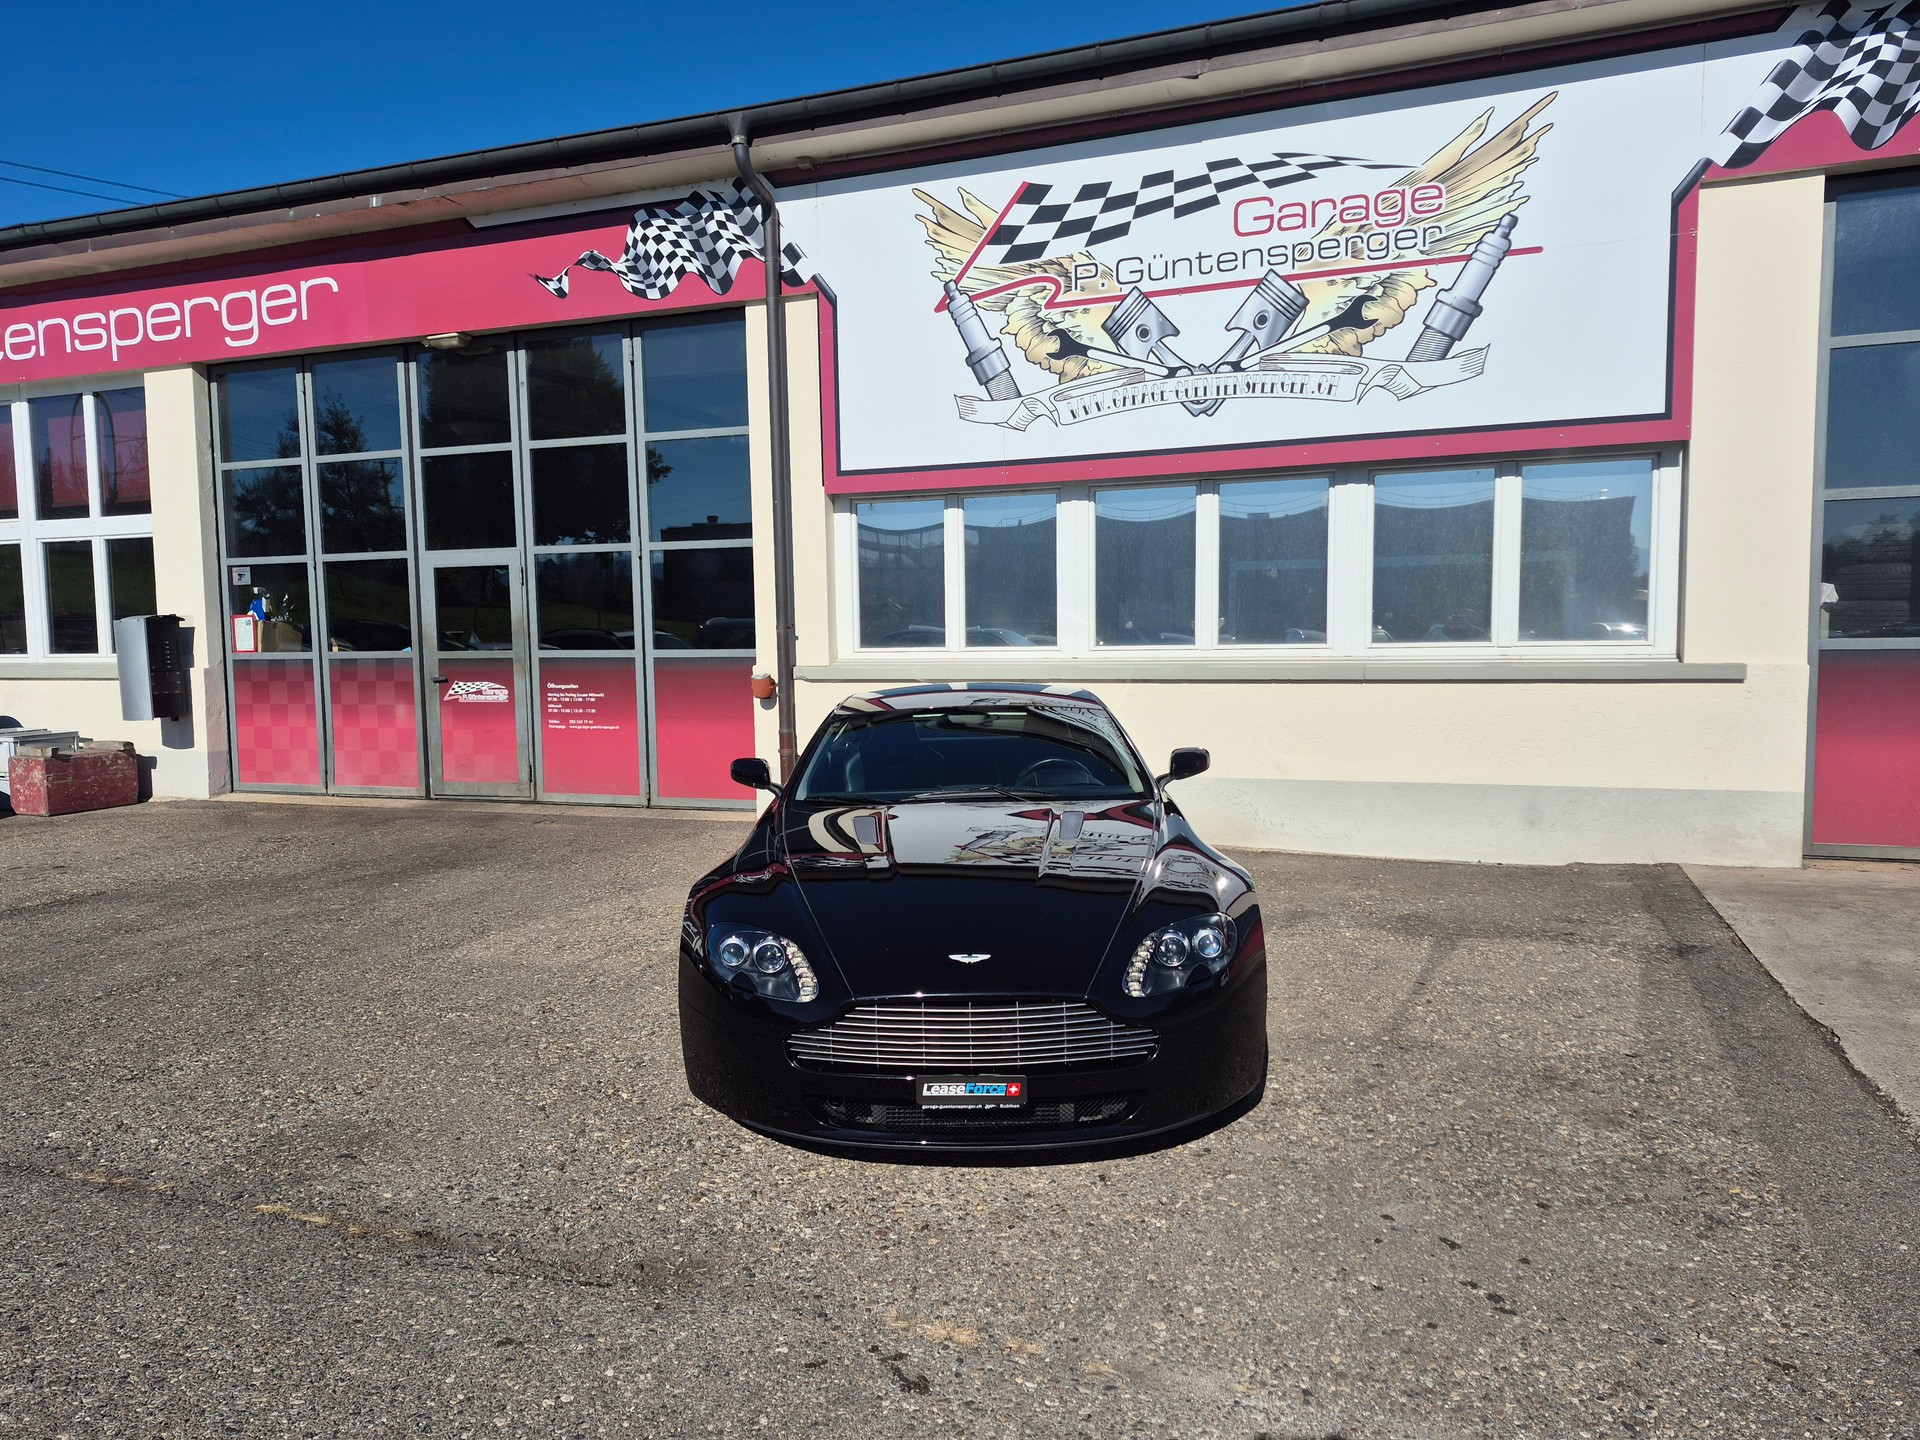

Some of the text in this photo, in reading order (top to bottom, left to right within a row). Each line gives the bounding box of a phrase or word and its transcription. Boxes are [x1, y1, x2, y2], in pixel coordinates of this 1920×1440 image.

[1233, 182, 1444, 238] Garage
[1072, 223, 1443, 291] P. Güntensperger
[0, 277, 339, 361] ensperger
[1066, 372, 1341, 420] WWW.GARAGE-GUENTENSPERGER.CH
[922, 1083, 1006, 1095] LeaseForce
